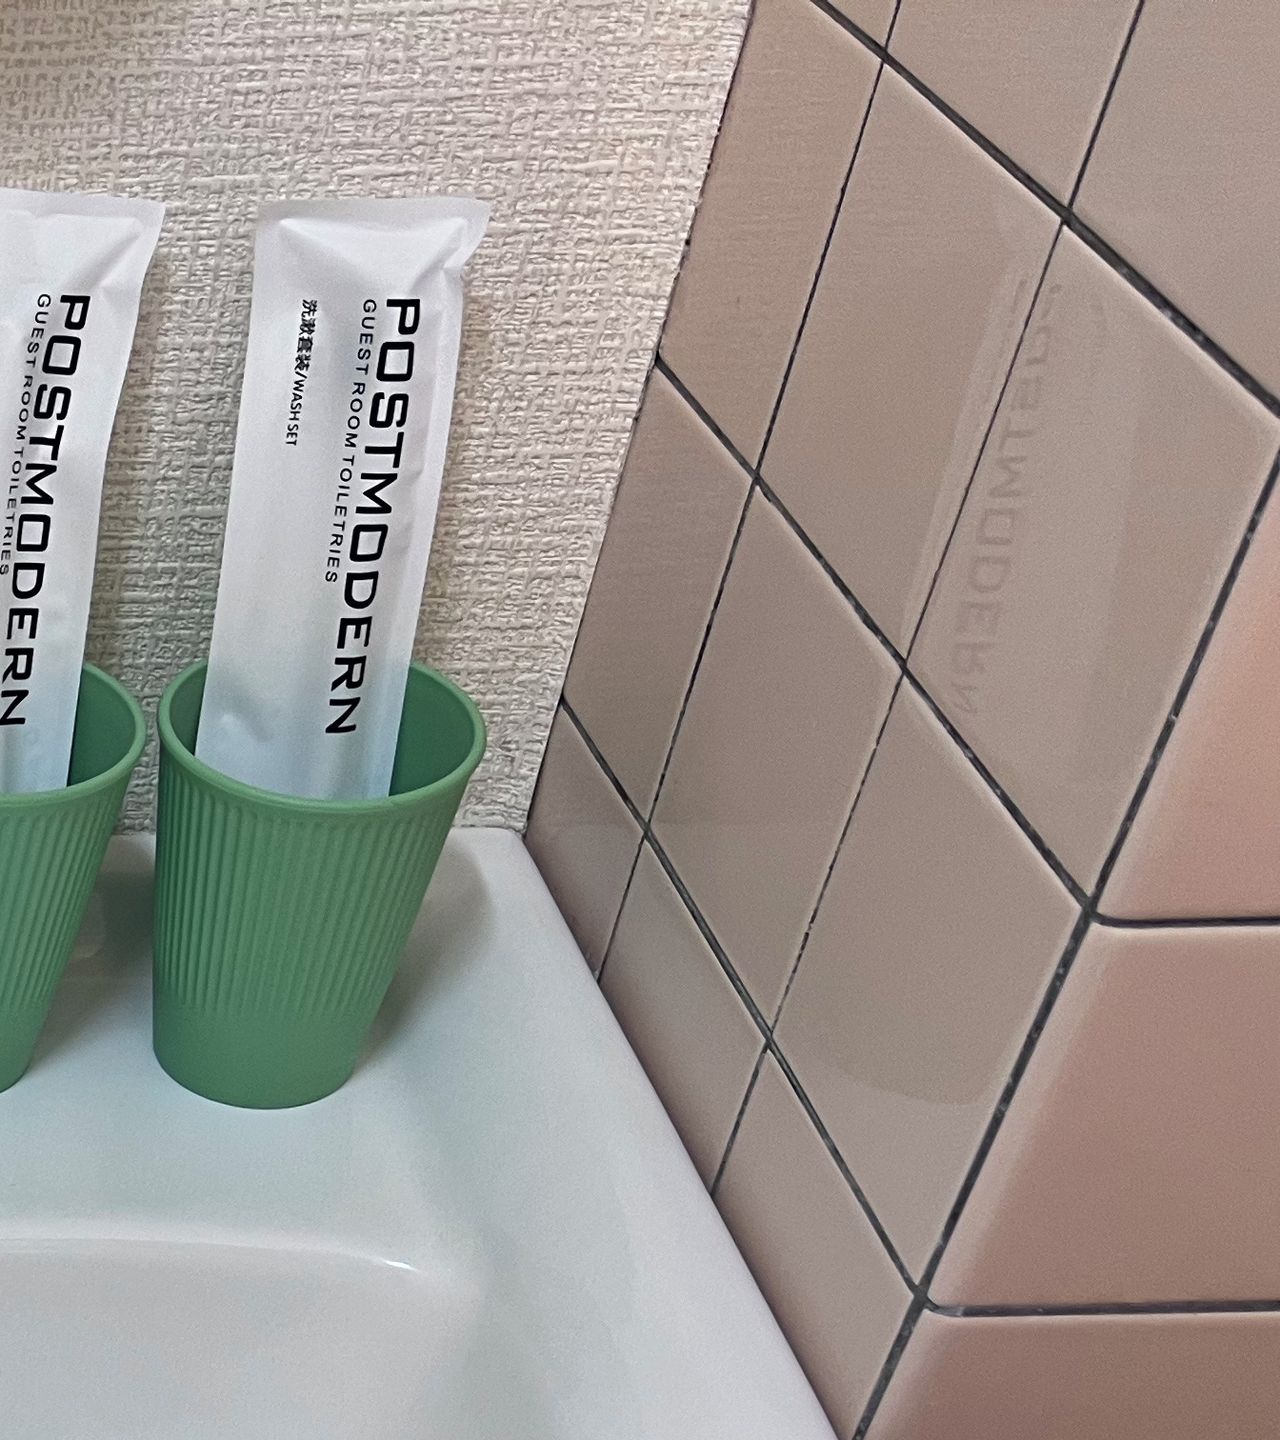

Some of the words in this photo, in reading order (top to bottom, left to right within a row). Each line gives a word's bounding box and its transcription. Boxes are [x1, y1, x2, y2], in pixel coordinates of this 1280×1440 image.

[25, 293, 52, 368] GUEST
[355, 299, 377, 375] GUEST
[15, 374, 34, 441] ROOM
[285, 423, 299, 446] SET
[344, 382, 366, 448] ROOM
[0, 447, 24, 576] TOILETRIES
[324, 454, 355, 583] TOILETRIES
[325, 298, 421, 734] POSTMODERN
